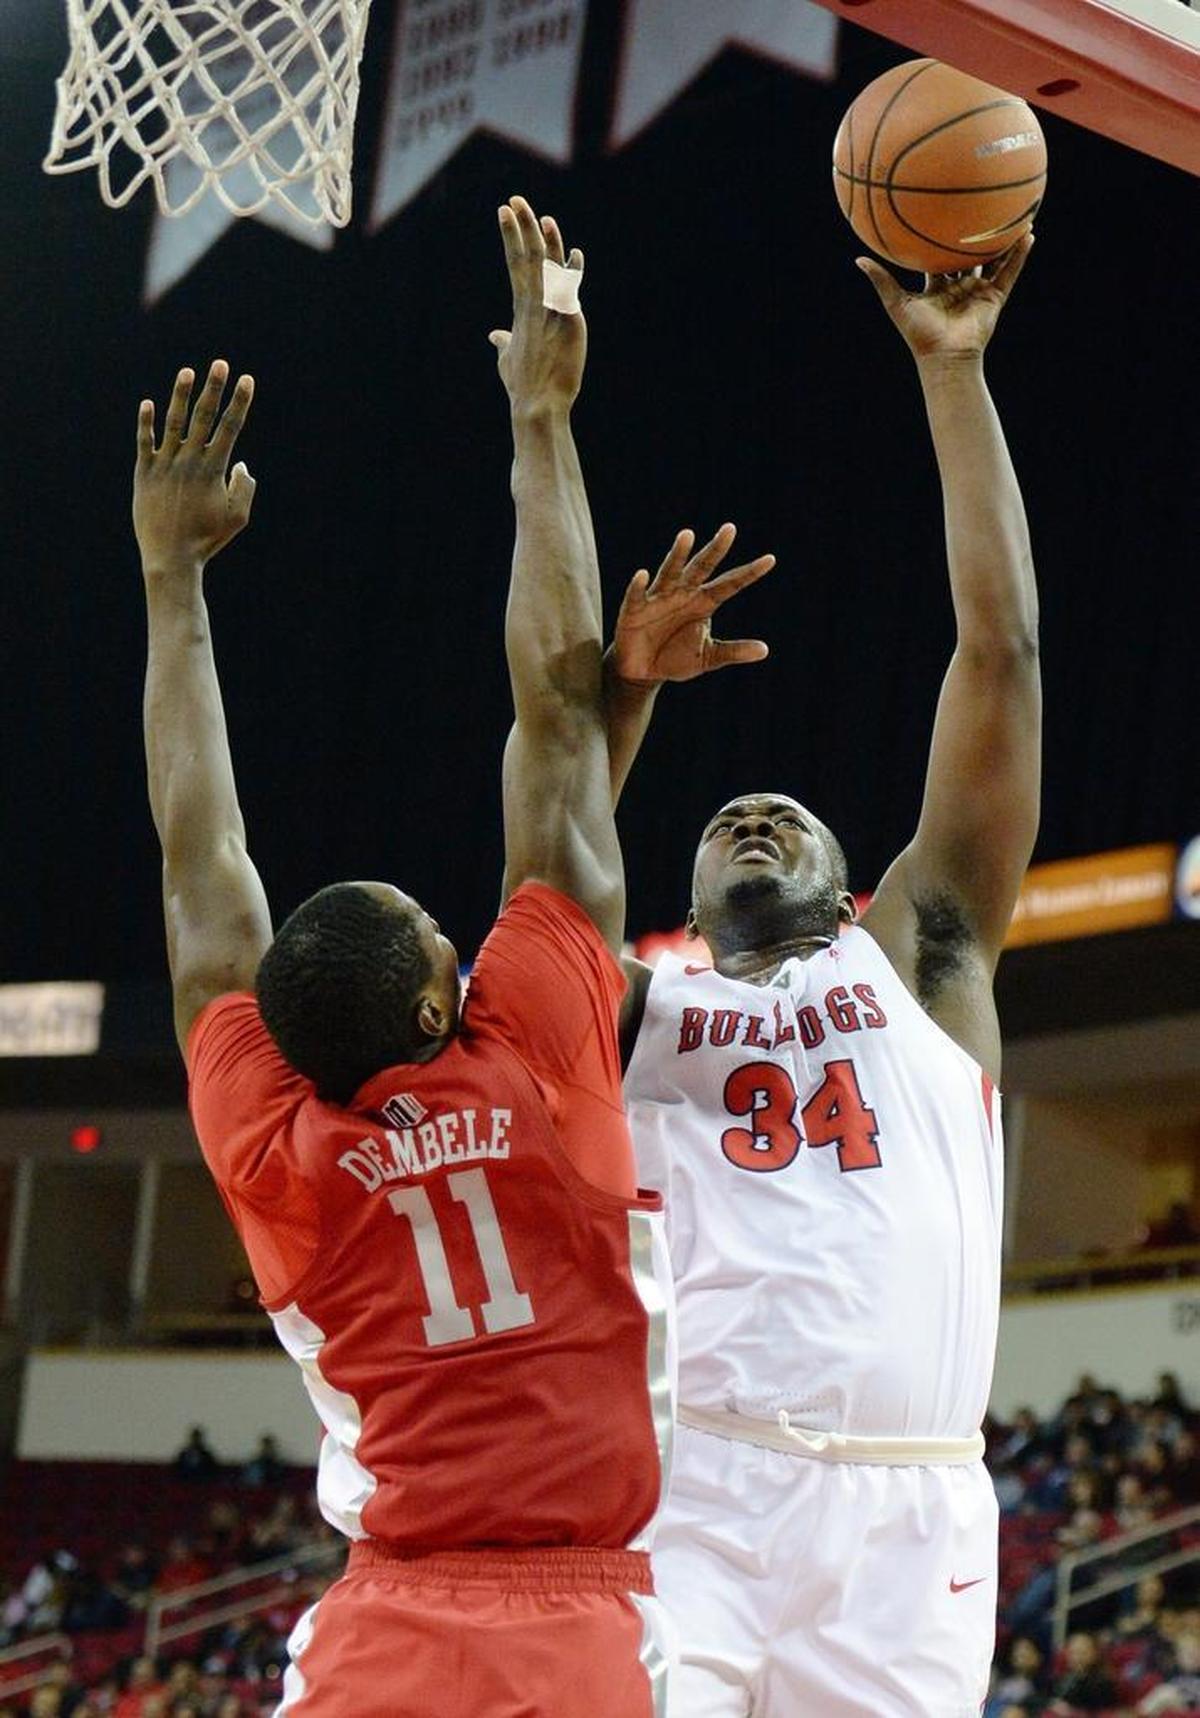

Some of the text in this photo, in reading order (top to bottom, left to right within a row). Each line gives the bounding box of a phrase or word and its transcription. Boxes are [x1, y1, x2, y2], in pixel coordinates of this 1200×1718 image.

[678, 983, 888, 1054] BULLOGS
[337, 1108, 512, 1193] DEMBELE
[721, 1058, 883, 1173] 34
[387, 1167, 536, 1347] 11
